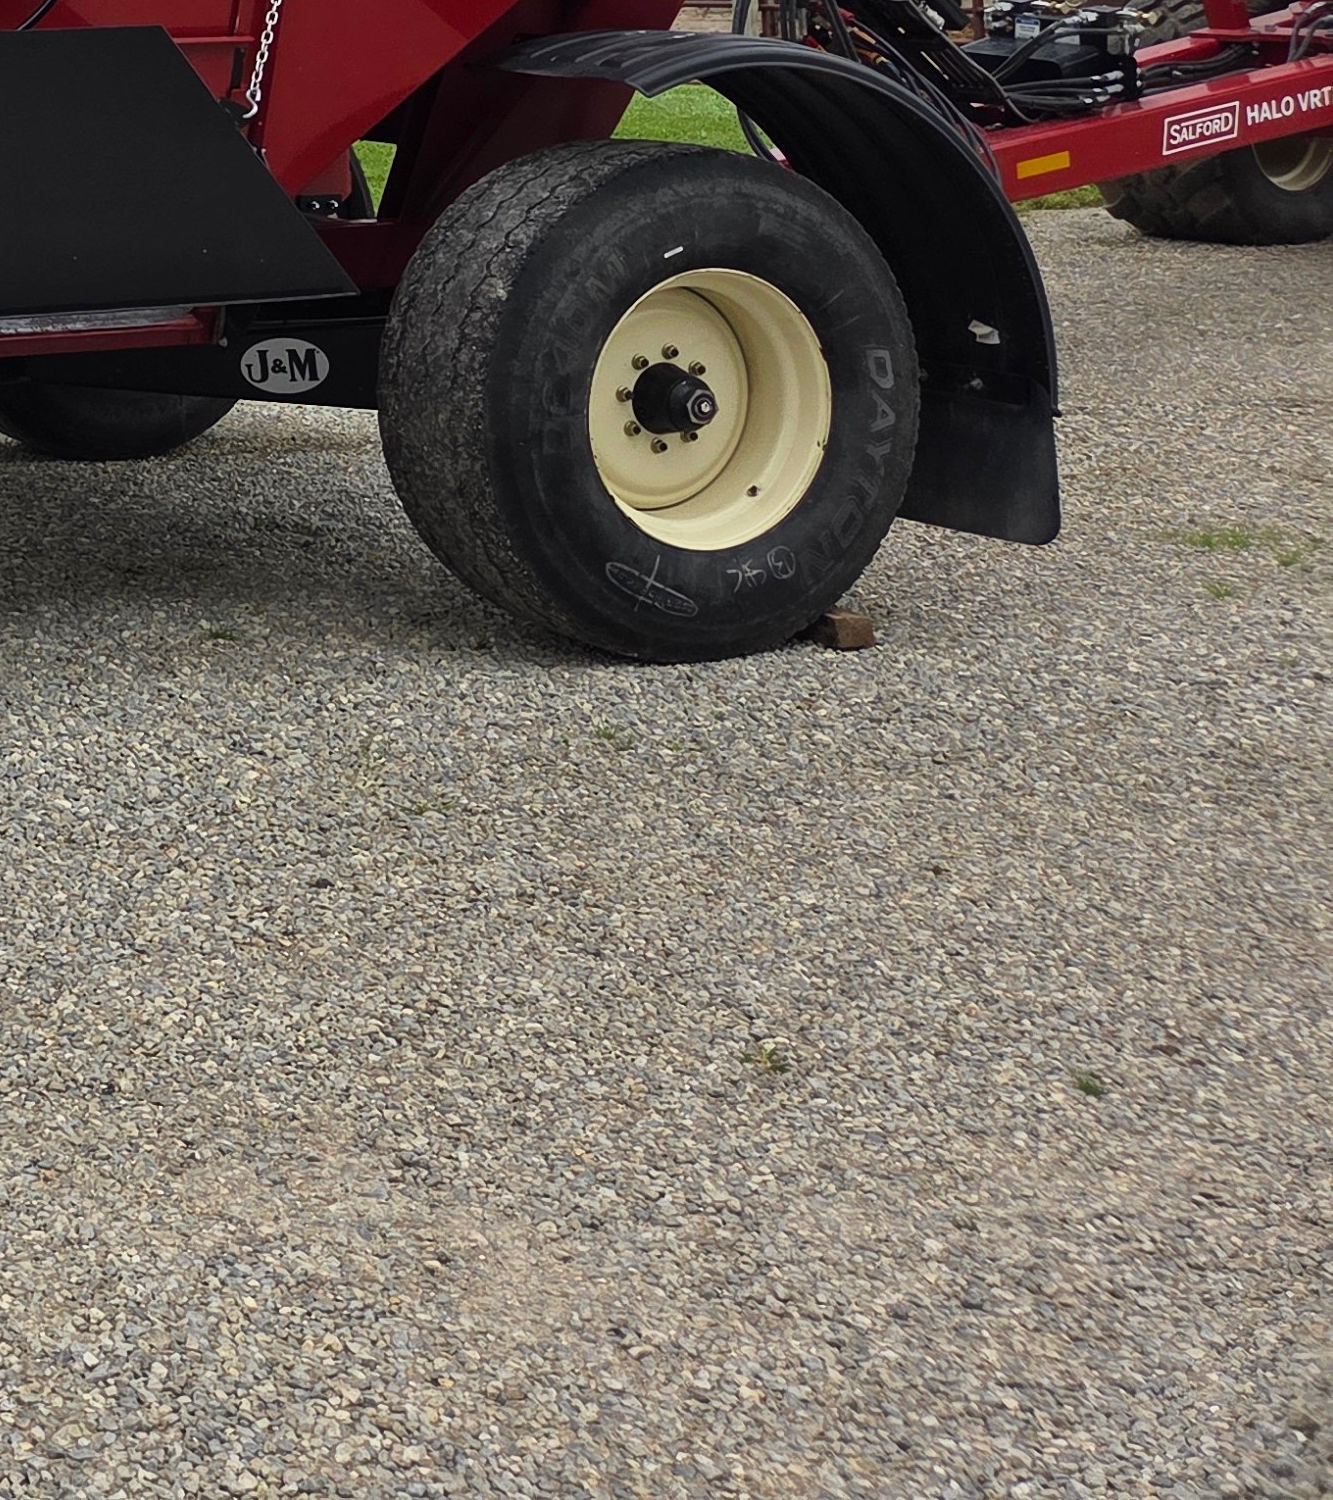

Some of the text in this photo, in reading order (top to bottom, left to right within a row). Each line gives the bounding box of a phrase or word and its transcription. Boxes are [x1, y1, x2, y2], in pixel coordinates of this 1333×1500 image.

[1169, 85, 1332, 146] SALFORD HALO VRT
[245, 348, 320, 383] J&M
[801, 346, 896, 582] DAYTON
